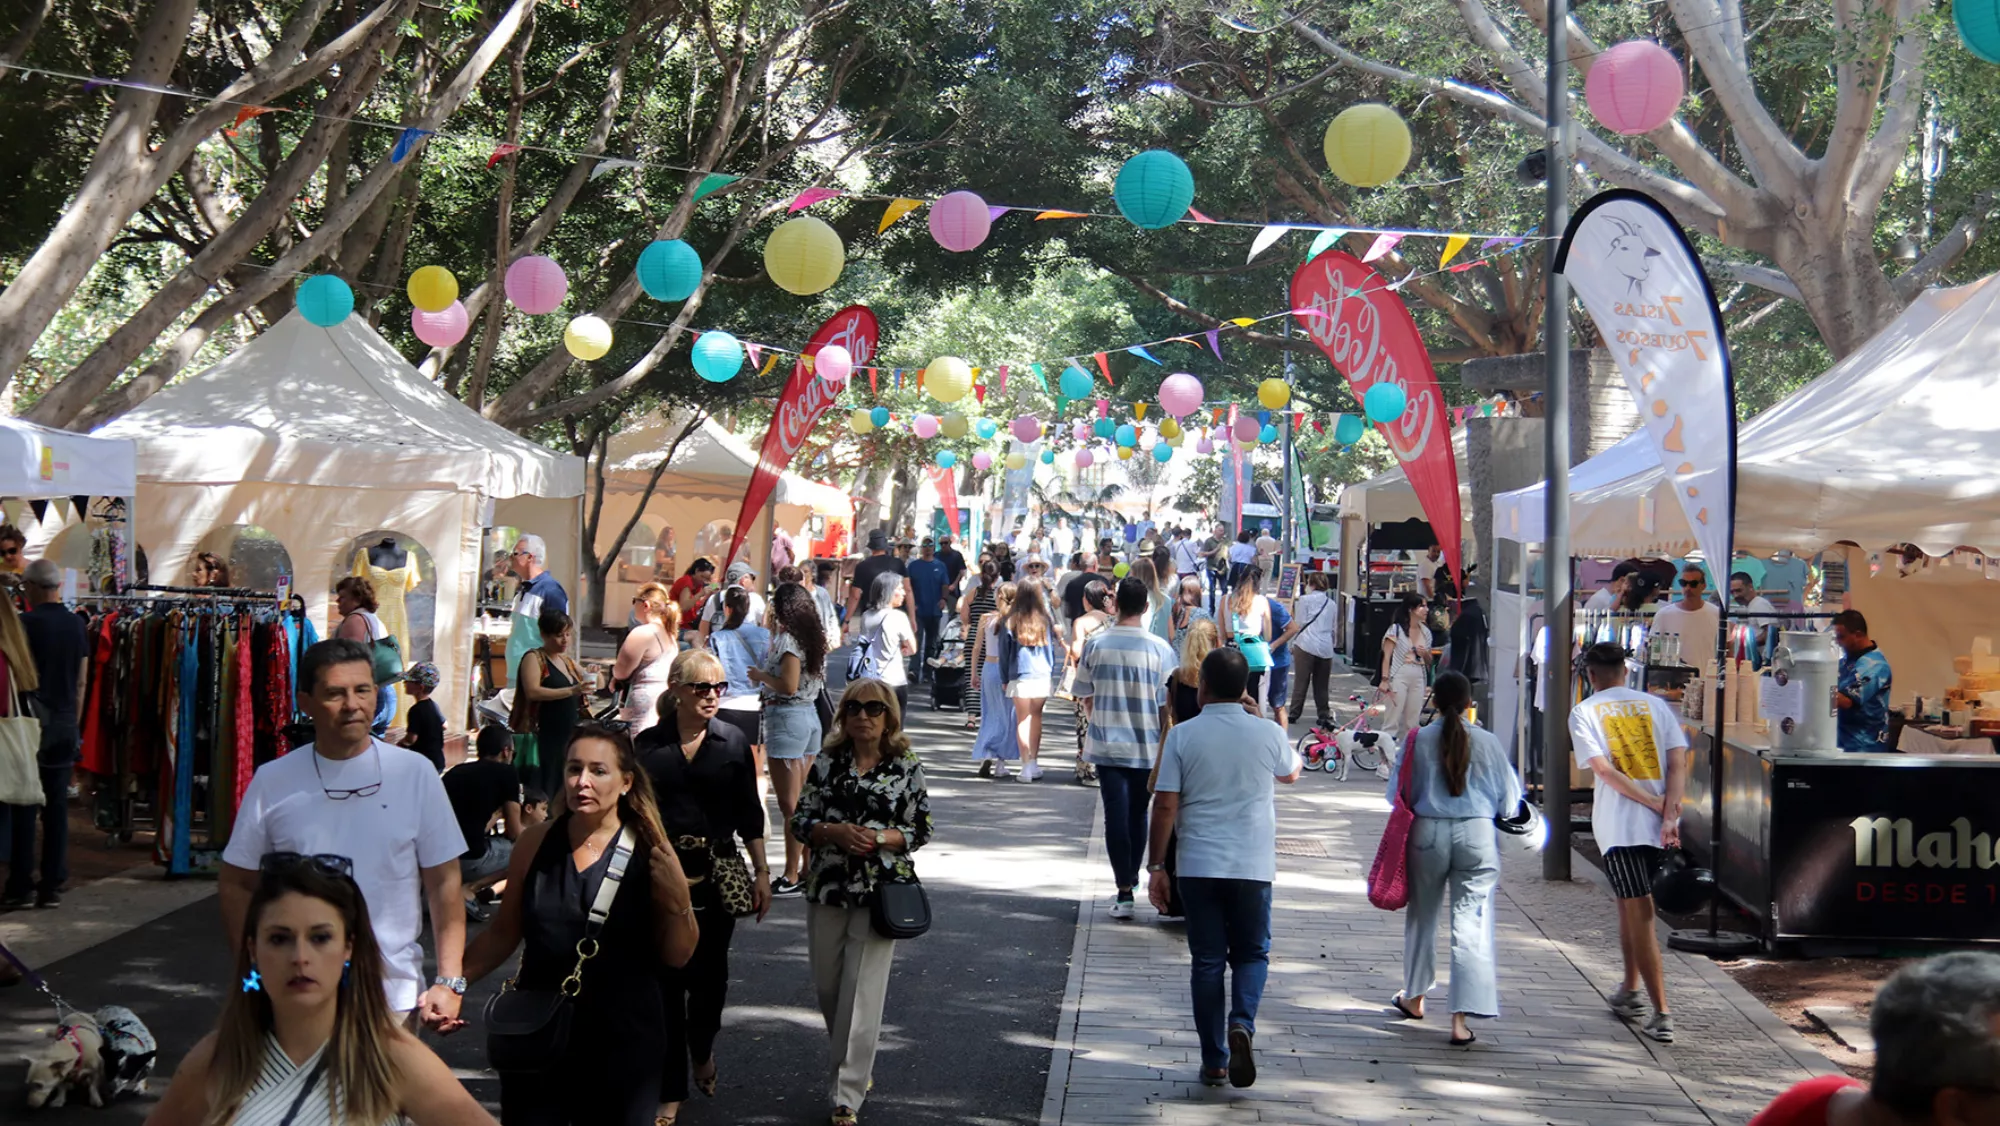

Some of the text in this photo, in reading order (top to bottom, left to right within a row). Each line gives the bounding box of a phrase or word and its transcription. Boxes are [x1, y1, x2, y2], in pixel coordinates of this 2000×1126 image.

[1599, 702, 1651, 719] ARTE
[1848, 816, 2000, 870] Mah
[1856, 881, 1967, 904] DESDE
